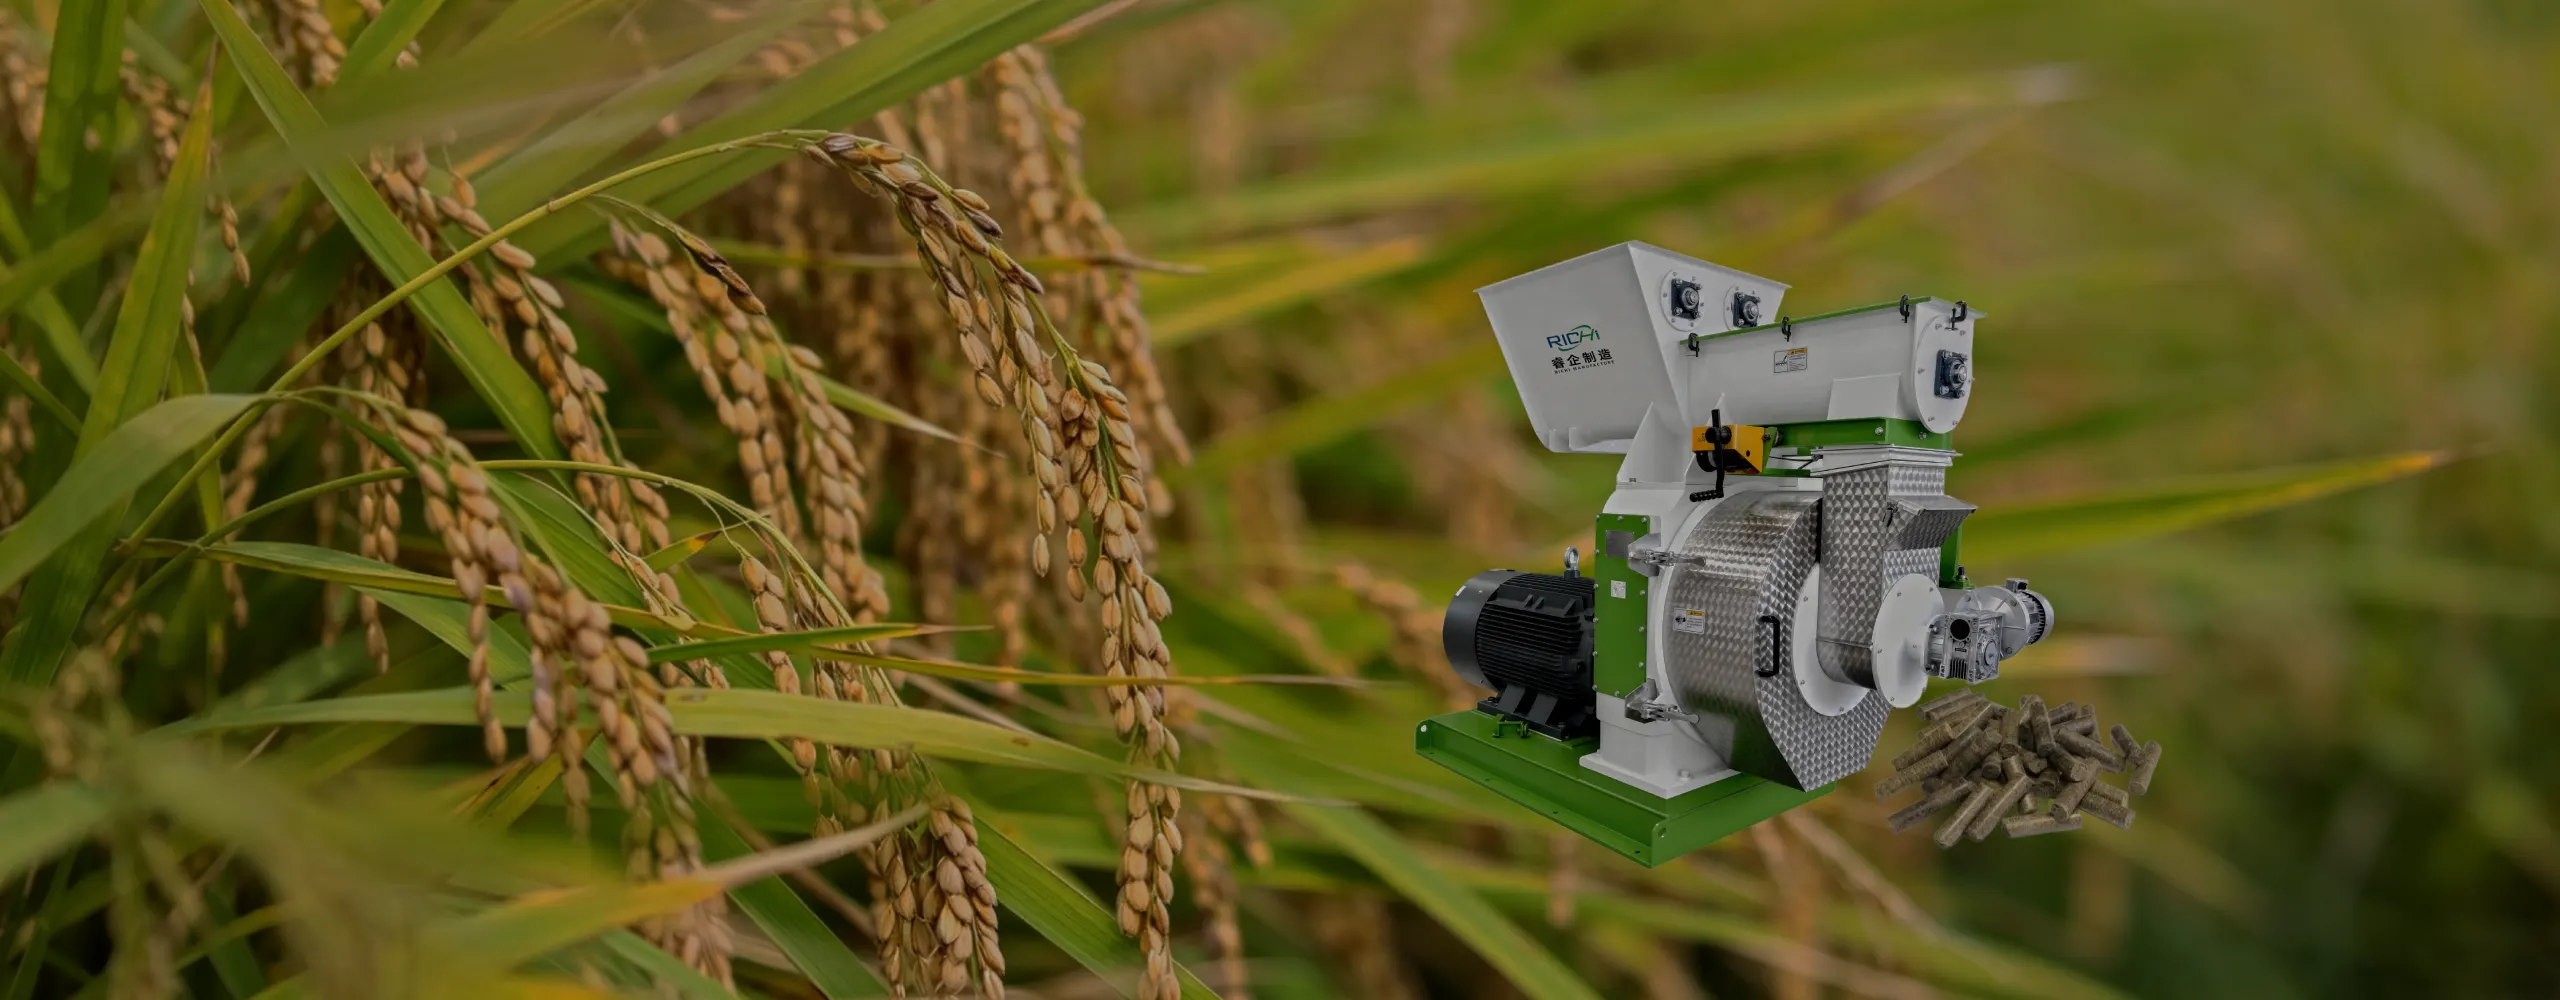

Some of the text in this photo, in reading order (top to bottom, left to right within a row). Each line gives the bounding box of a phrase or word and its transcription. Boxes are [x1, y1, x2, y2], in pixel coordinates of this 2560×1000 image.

[1551, 348, 1613, 369] 睿企制造
[1572, 360, 1615, 371] MANUFACTURE
